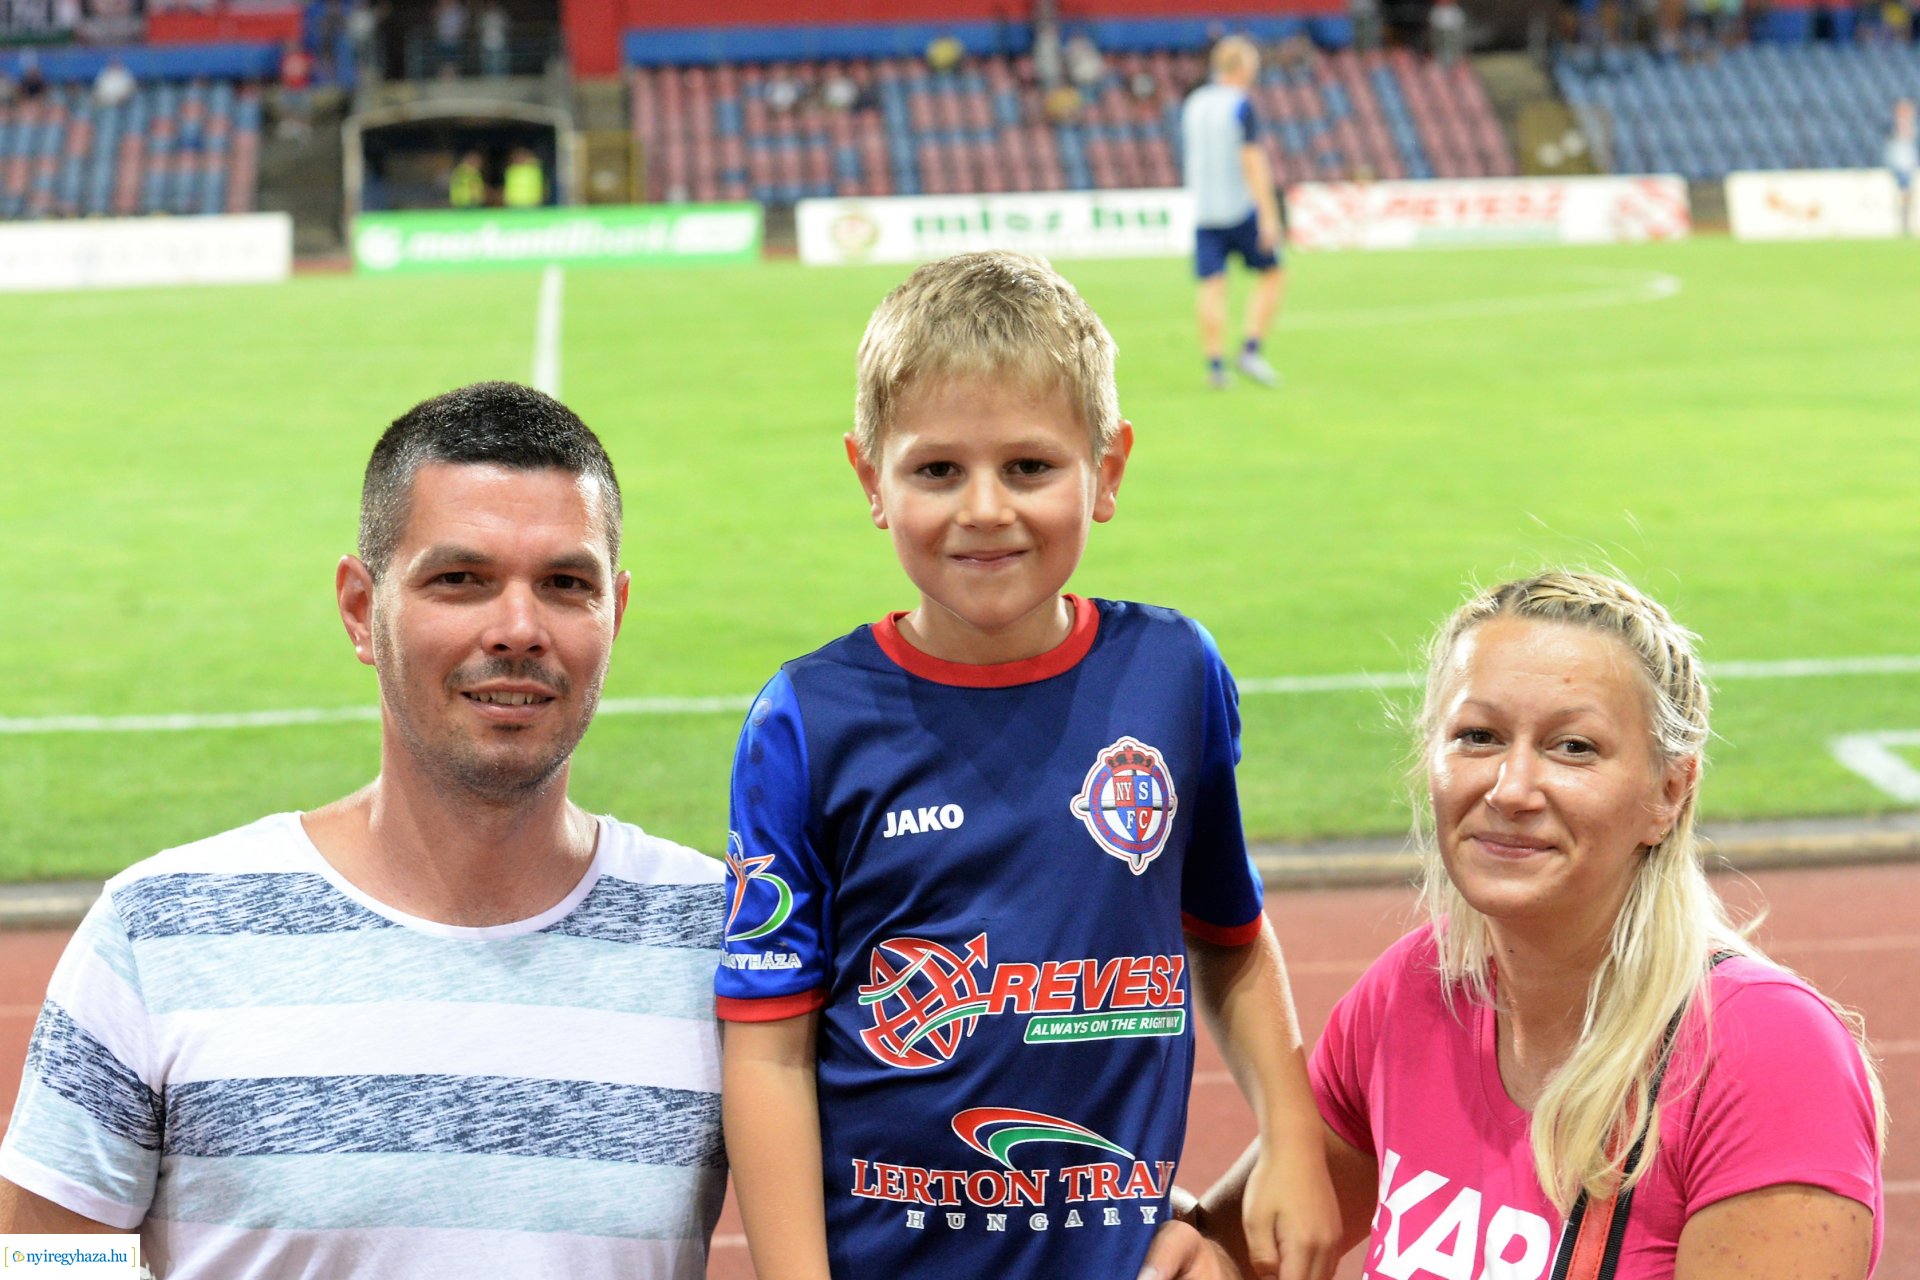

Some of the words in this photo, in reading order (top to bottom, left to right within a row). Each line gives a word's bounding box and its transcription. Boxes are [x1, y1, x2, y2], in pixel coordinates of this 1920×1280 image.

[1115, 781, 1132, 801] NY
[1138, 781, 1149, 801] S
[882, 803, 965, 838] JAKO
[1126, 810, 1136, 830] F
[1138, 810, 1149, 830] C
[987, 955, 1185, 1015] REVESZ
[1031, 1021, 1089, 1036] ALWAYS
[1090, 1020, 1109, 1033] ON
[1111, 1018, 1137, 1031] THE
[1139, 1016, 1167, 1030] RIGHT
[851, 1158, 1048, 1208] LERTON
[905, 1206, 1158, 1232] HUNGARY
